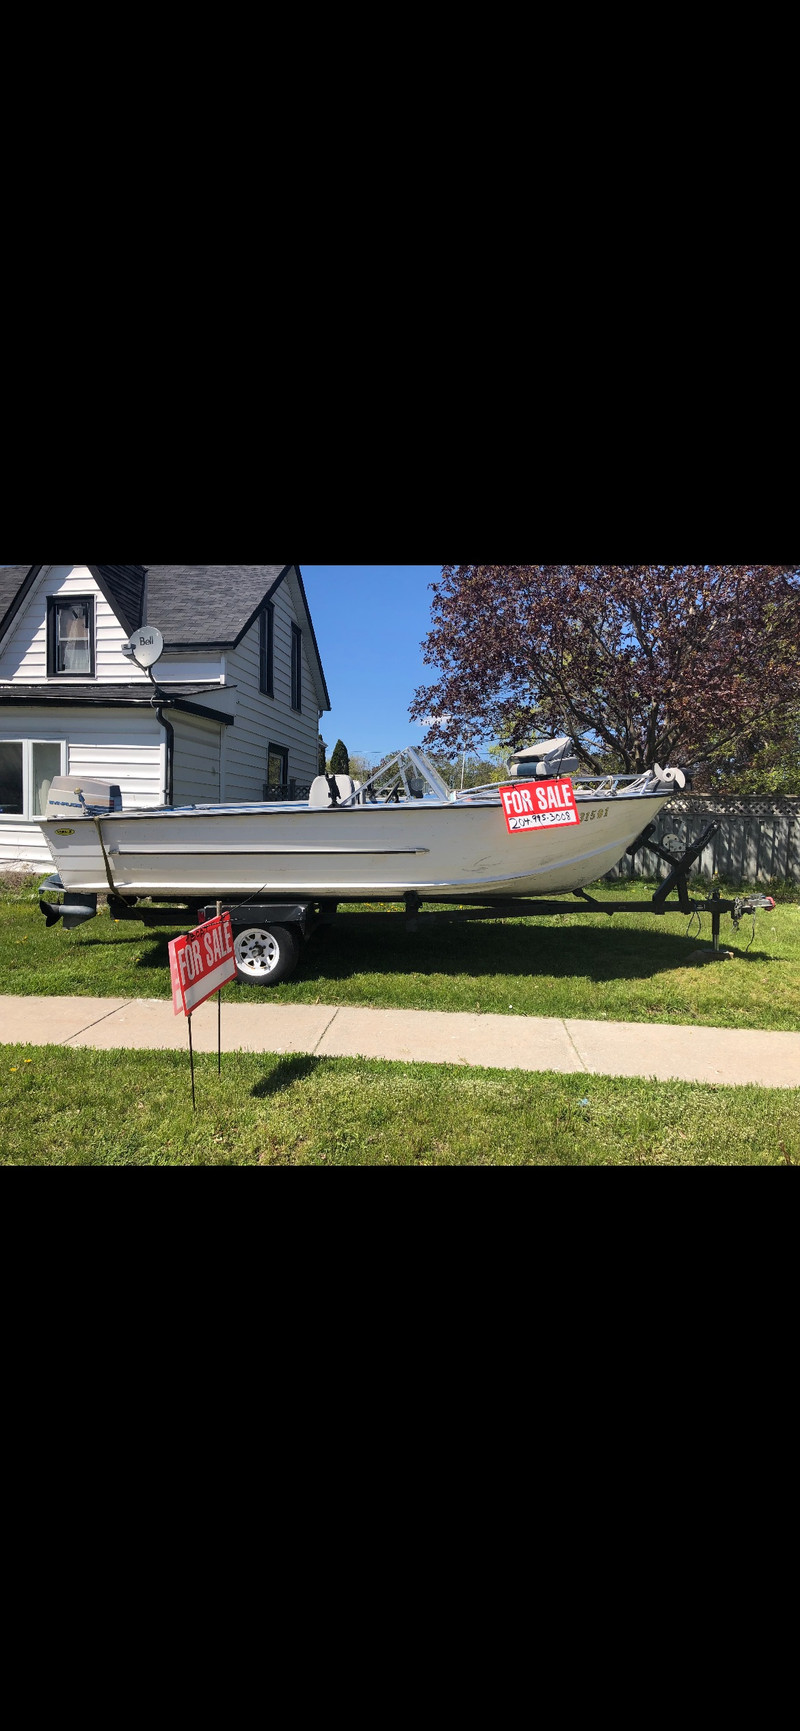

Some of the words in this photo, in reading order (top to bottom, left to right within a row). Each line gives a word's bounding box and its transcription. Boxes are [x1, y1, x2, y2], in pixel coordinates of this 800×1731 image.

[139, 636, 154, 646] Bell
[502, 789, 534, 815] FOR
[535, 784, 573, 810] SALE
[177, 939, 204, 986] FOR
[203, 921, 232, 968] SALE
